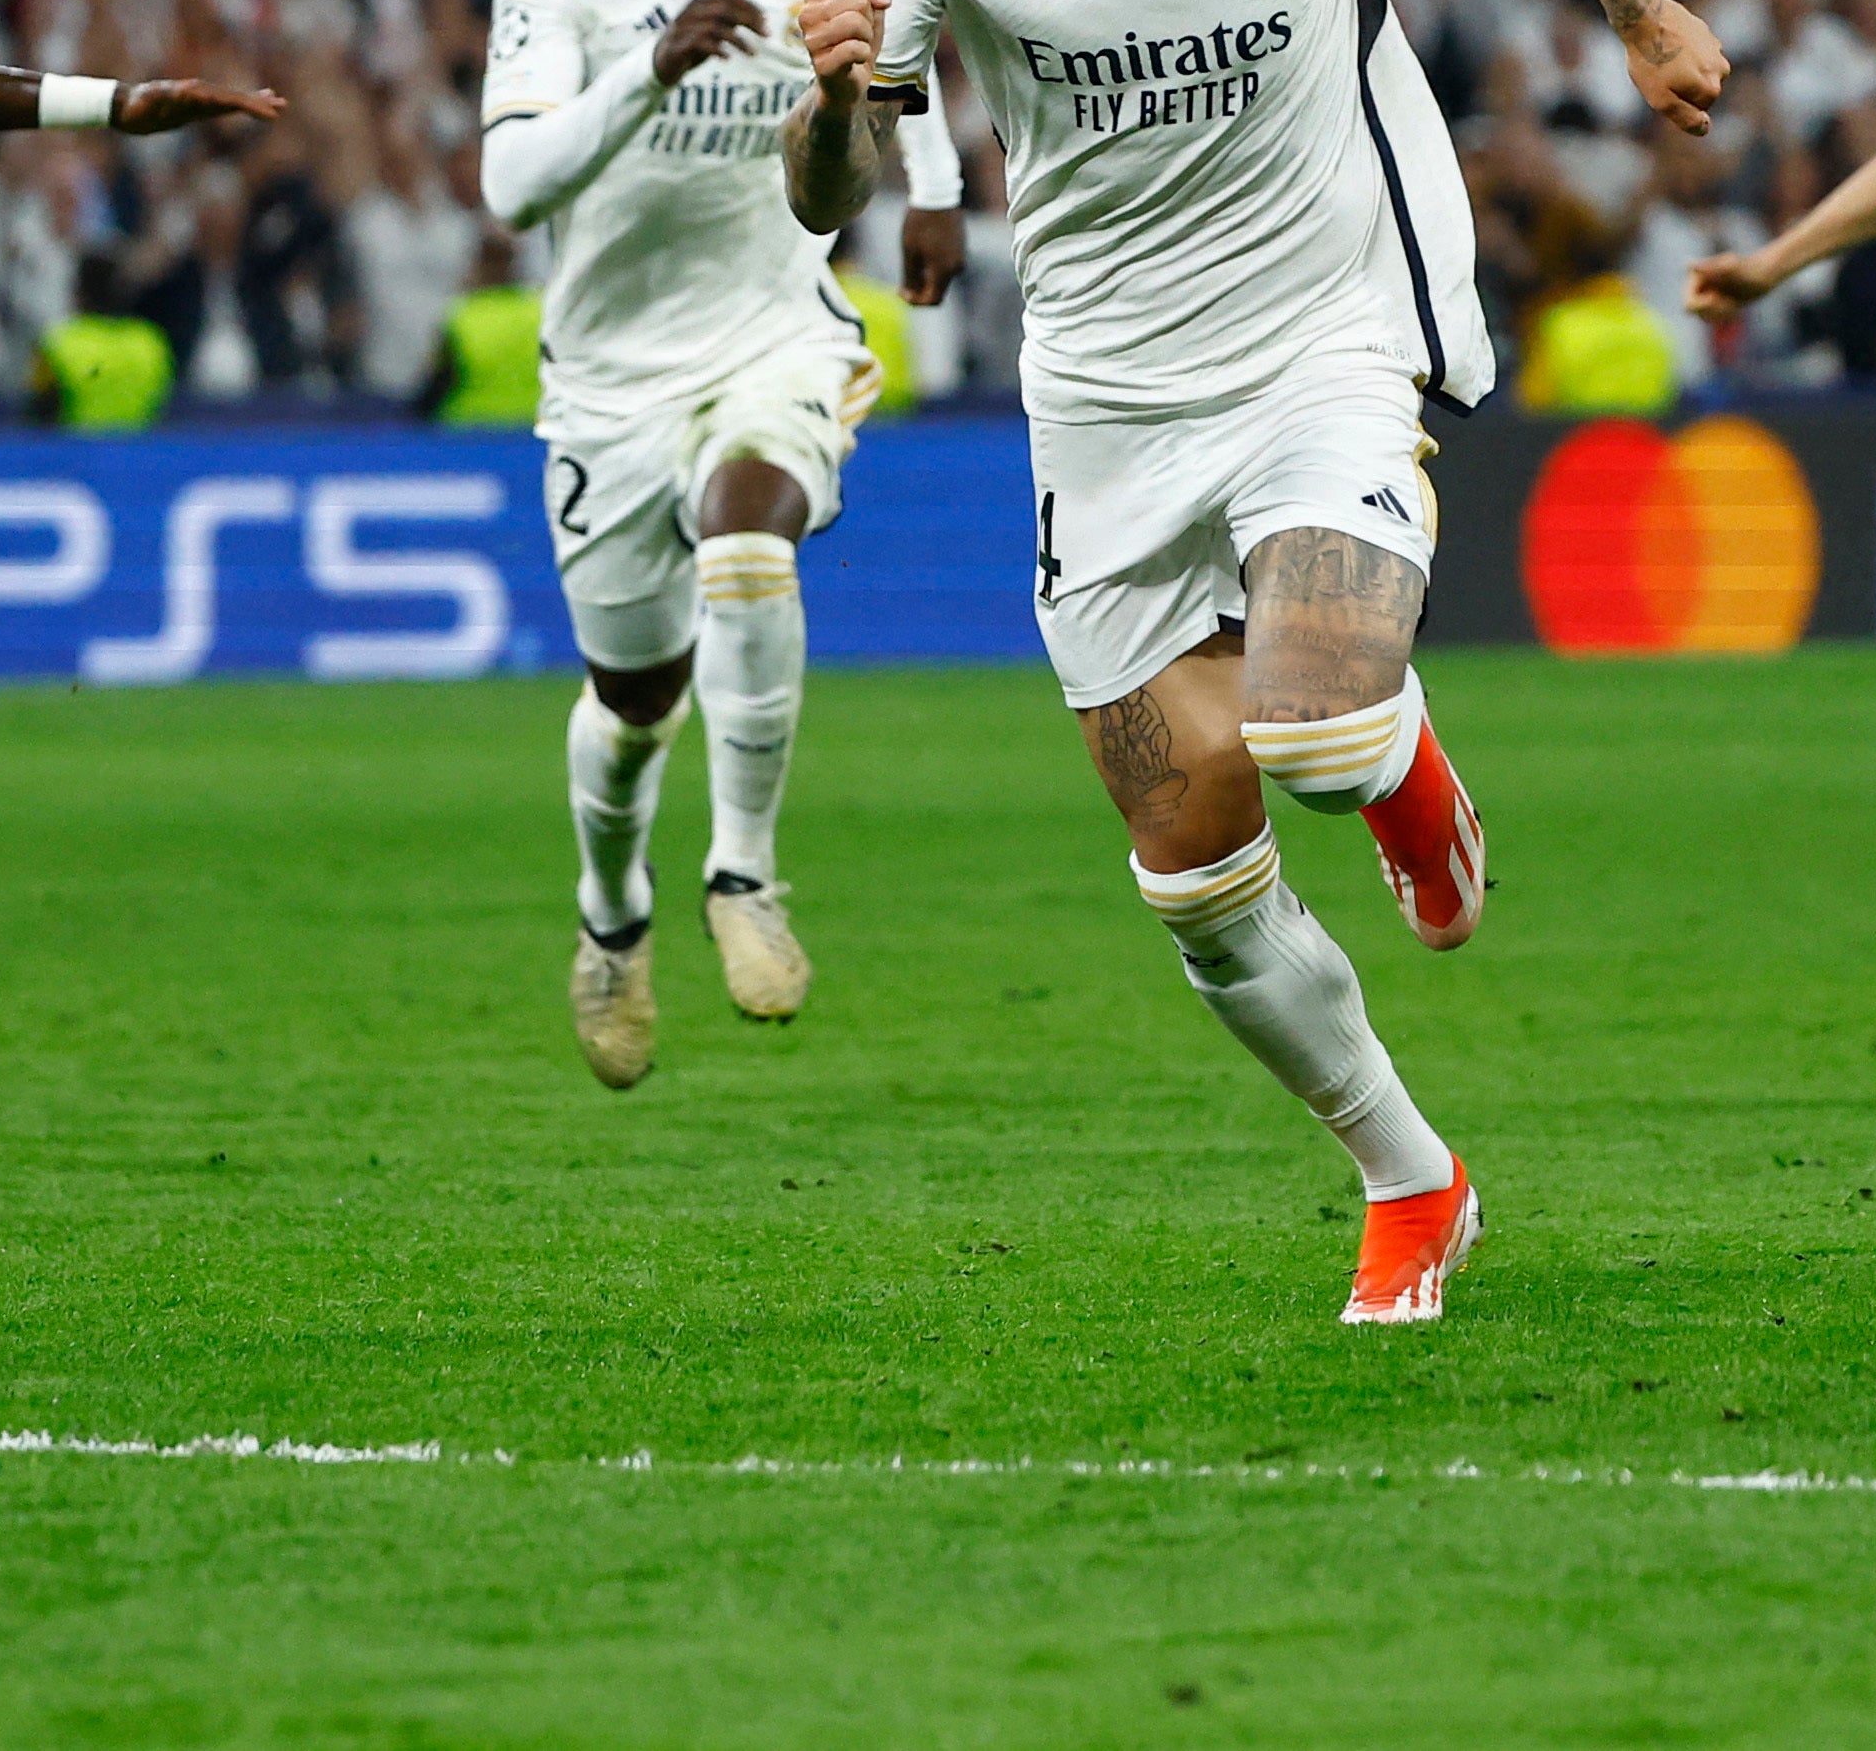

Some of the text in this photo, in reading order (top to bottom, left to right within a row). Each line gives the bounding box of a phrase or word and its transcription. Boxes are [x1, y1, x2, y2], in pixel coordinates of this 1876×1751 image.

[1017, 10, 1293, 87] Emirates
[1074, 70, 1260, 133] FLY BETTER
